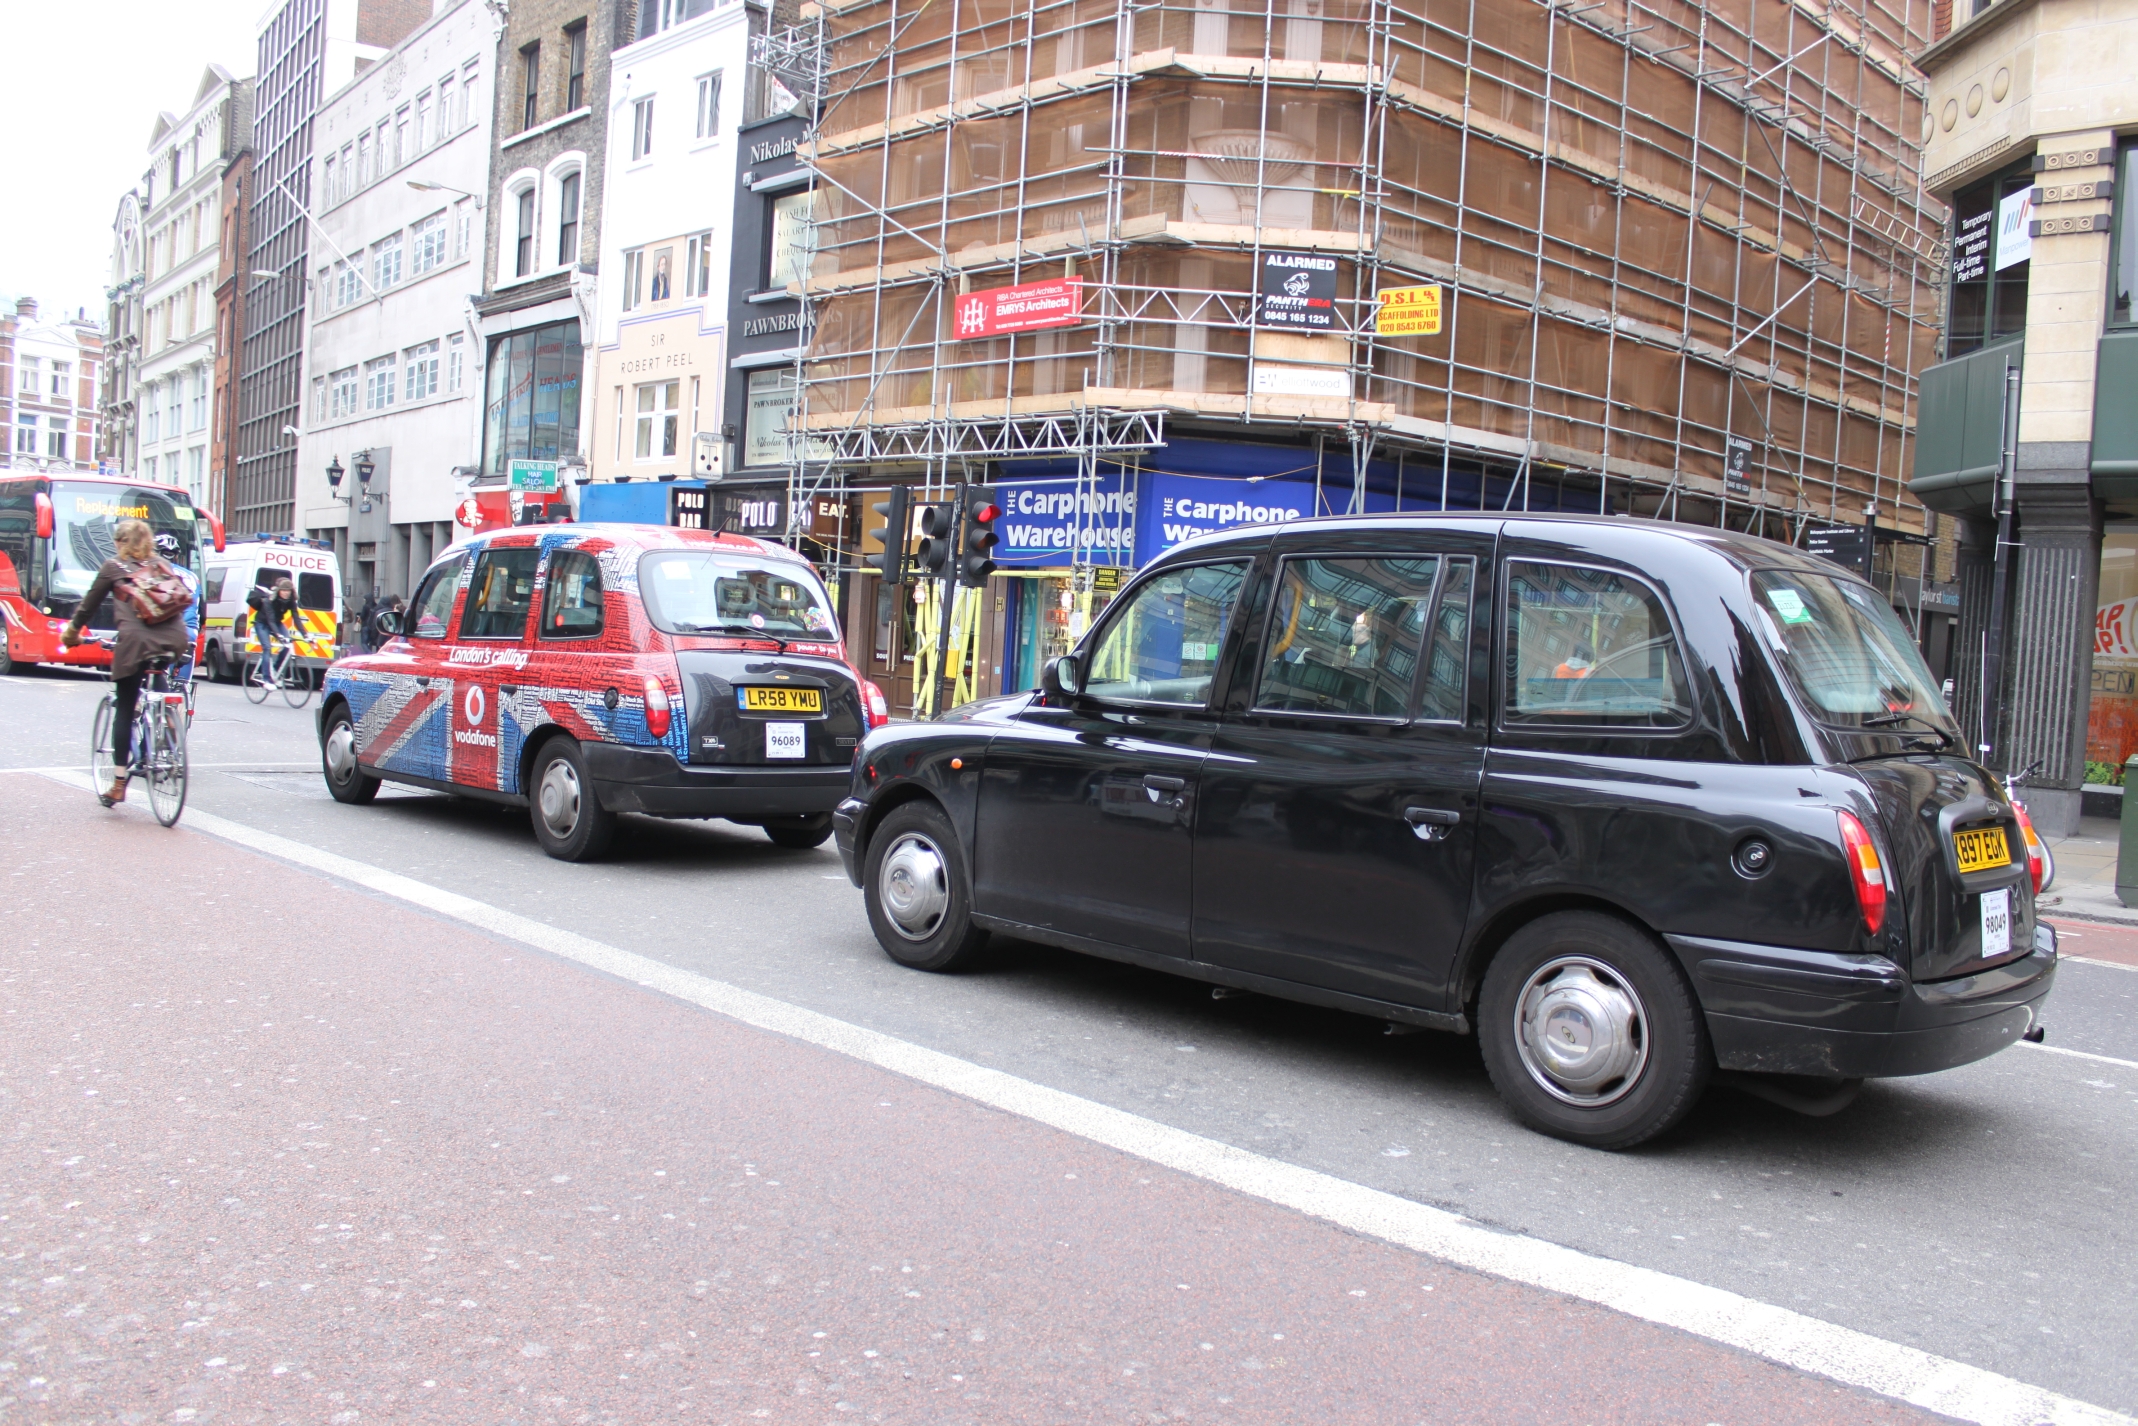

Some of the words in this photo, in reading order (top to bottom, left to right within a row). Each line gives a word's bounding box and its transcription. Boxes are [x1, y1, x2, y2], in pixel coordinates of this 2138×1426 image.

[750, 137, 798, 165] Nikolas
[779, 207, 799, 221] CASH
[1962, 210, 1992, 230] Temporary
[1955, 225, 1987, 248] Permanent
[776, 244, 808, 257] CHEQUE
[1966, 240, 1987, 256] Interim
[2000, 238, 2029, 255] Manpower
[1267, 255, 1336, 271] ALARMED
[1953, 255, 1981, 274] Full-time
[1958, 266, 1984, 283] Part-time
[997, 293, 1009, 302] RIBA
[1009, 289, 1036, 300] Chartered
[1036, 285, 1063, 295] Architects
[1266, 295, 1331, 308] PANTHERA
[996, 301, 1025, 316] EMRYS
[1026, 297, 1069, 312] Architects
[1379, 309, 1424, 321] SCAFFOLDING
[1426, 309, 1439, 318] LTD
[1265, 311, 1287, 320] 0845
[1289, 313, 1305, 322] 165
[1308, 315, 1329, 324] 1234
[1381, 323, 1394, 332] 020
[1397, 322, 1416, 331] 8543
[1417, 320, 1436, 330] 6760
[651, 333, 665, 347] SIR
[621, 357, 661, 374] ROBERT
[667, 352, 693, 368] PEEL
[539, 372, 577, 393] HEADS
[755, 436, 780, 448] Nikolas
[1729, 437, 1752, 451] ALARMED
[513, 461, 537, 470] TALKING
[537, 463, 555, 471] HEADS
[522, 477, 546, 486] SALON
[76, 497, 149, 519] Replacement
[677, 493, 704, 509] POLO
[1007, 490, 1016, 516] THE
[1018, 489, 1137, 519] Carphone
[741, 501, 777, 527] POLO
[818, 502, 848, 518] EAT.
[1163, 497, 1173, 517] THE
[1175, 498, 1300, 524] Carphone
[679, 513, 702, 529] BAR
[1006, 522, 1135, 548] Warehouse
[361, 546, 375, 555] POLIC
[265, 552, 326, 571] POLICE
[1921, 588, 1936, 606] aylor
[2095, 603, 2125, 631] AP
[797, 643, 817, 652] power
[819, 645, 827, 653] to
[827, 647, 837, 655] you
[876, 652, 888, 660] SOU
[449, 647, 492, 664] London's
[492, 648, 528, 671] calling
[2090, 671, 2131, 694] PEN
[747, 690, 787, 706] LR58
[790, 692, 817, 708] YMU
[617, 712, 641, 720] Embankment
[455, 729, 496, 747] vodafone
[672, 716, 681, 746] Margaret's
[680, 714, 689, 755] Strawberry
[771, 735, 801, 746] 96089
[1983, 830, 2006, 861] EGK
[1985, 913, 2006, 934] 98049
